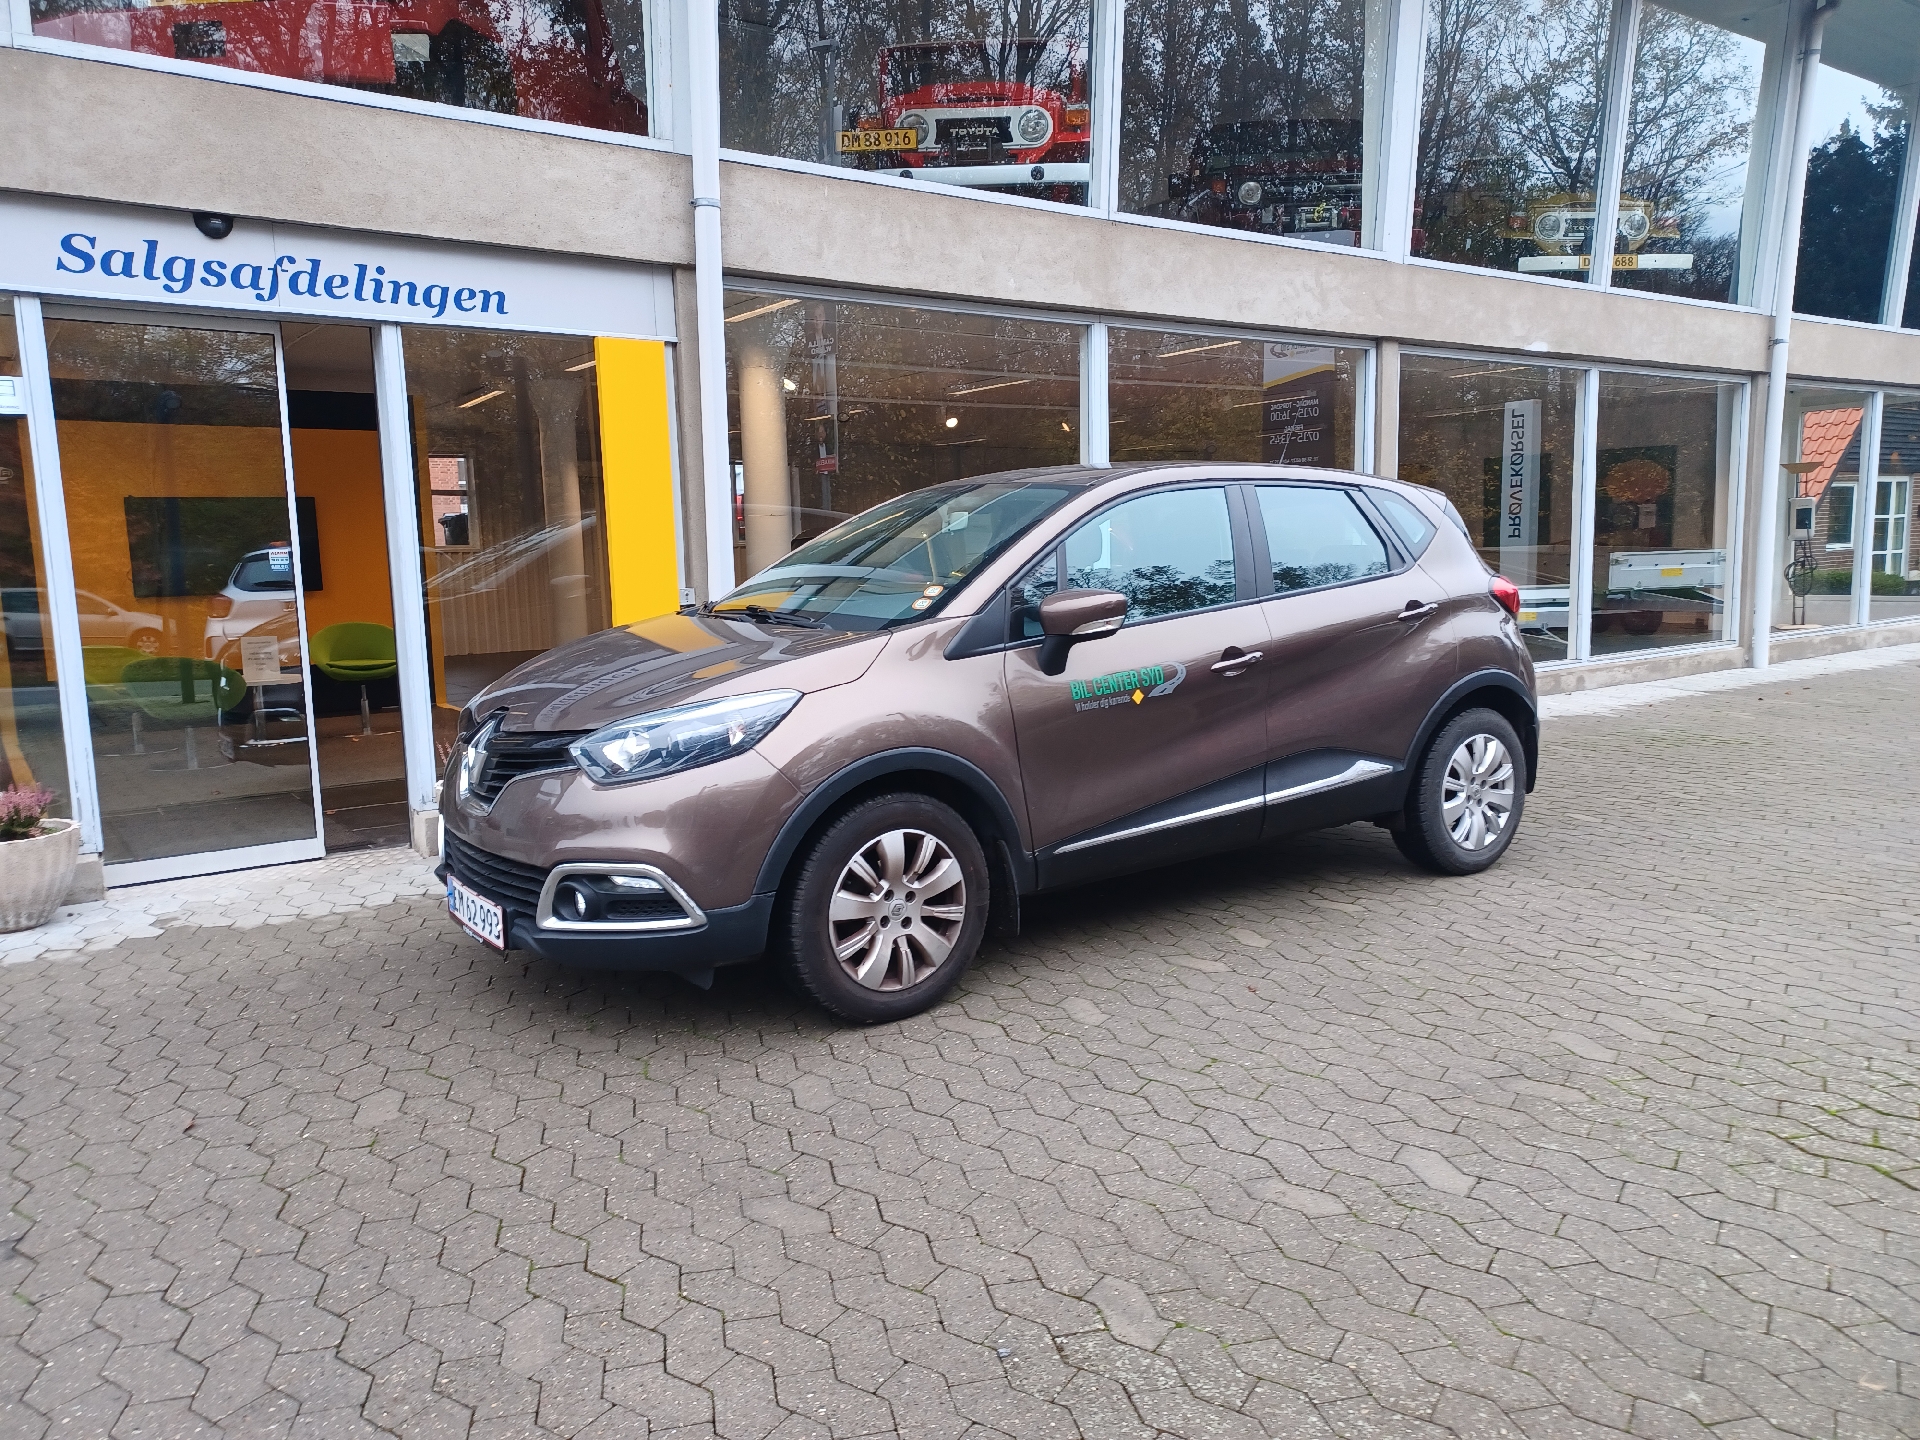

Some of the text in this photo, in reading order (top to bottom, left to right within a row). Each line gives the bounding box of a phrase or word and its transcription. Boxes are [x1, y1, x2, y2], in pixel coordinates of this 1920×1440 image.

[841, 131, 911, 148] DM 88 916
[950, 126, 1000, 136] TOYOTA
[1615, 256, 1634, 267] 688
[56, 232, 509, 318] Salgsafdelingen
[1070, 665, 1165, 700] BIL CENTER SYD
[1080, 700, 1100, 711] holder
[1100, 698, 1109, 709] dig
[466, 896, 478, 928] 62
[480, 904, 501, 941] 993
